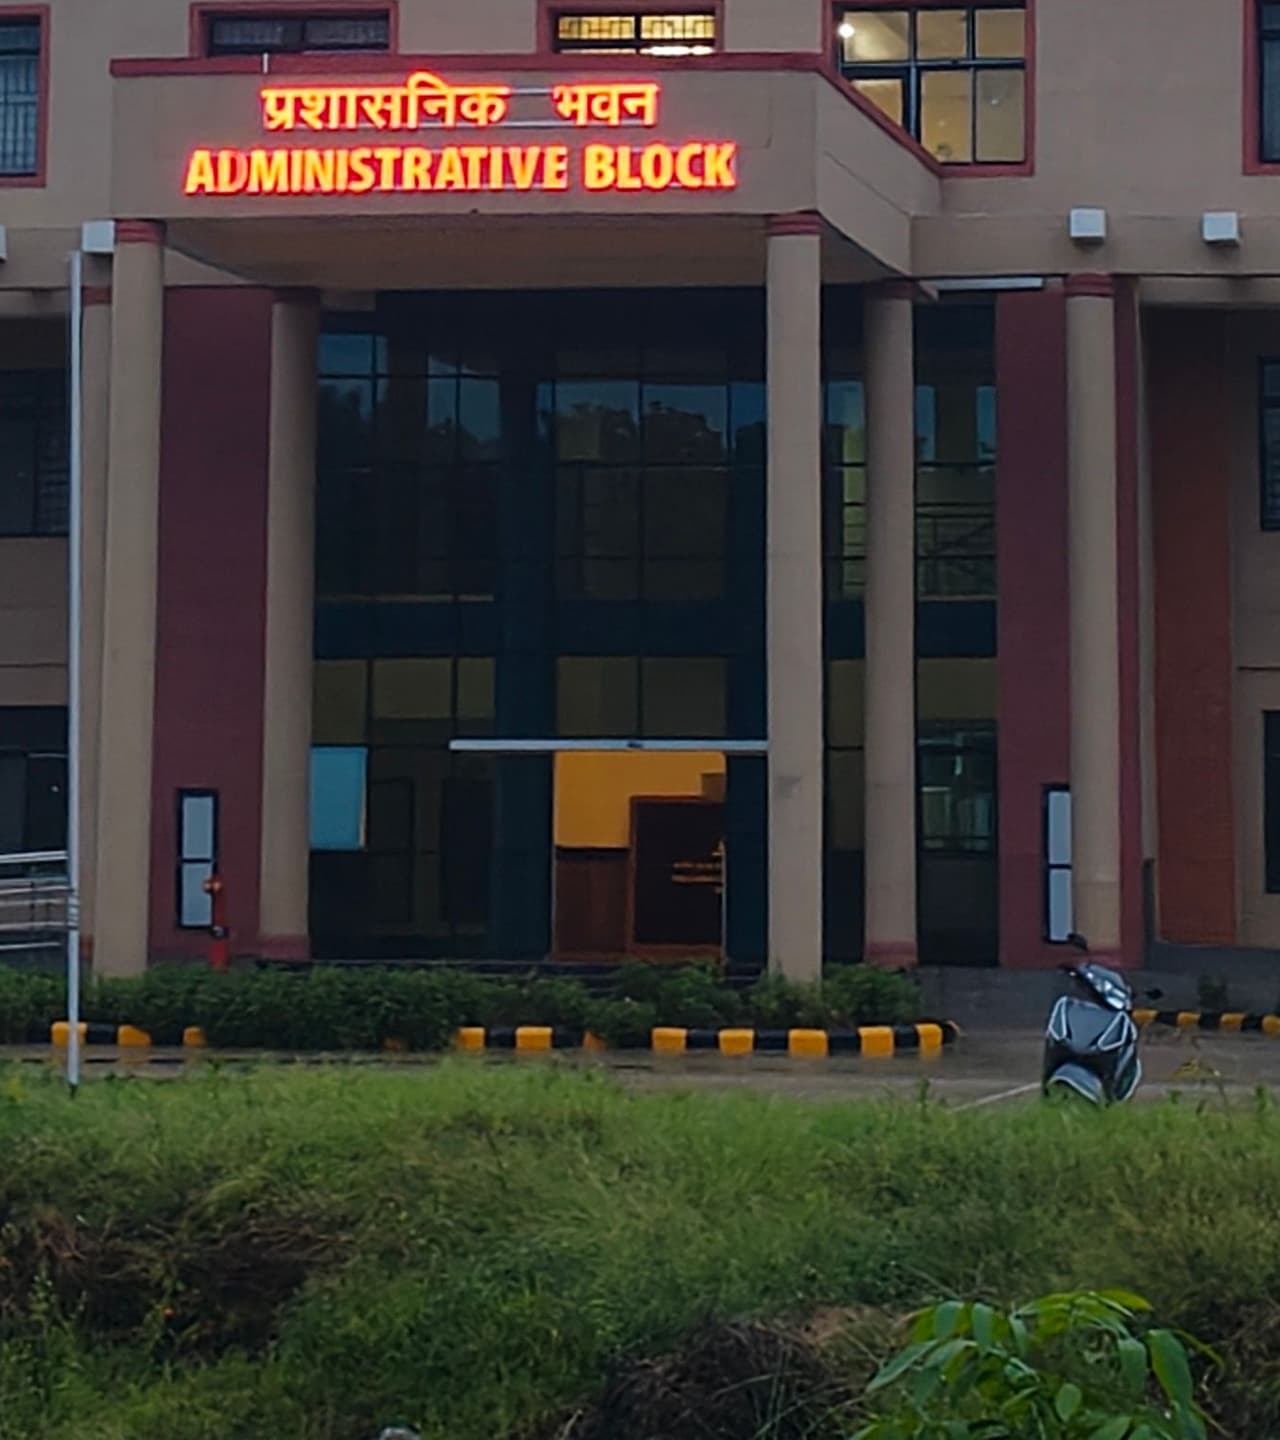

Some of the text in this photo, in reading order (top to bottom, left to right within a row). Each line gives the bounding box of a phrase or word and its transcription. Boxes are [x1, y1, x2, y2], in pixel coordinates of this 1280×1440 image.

[261, 71, 659, 131] प्रशासनिक भवन
[184, 142, 737, 194] ADMINISTRATIVE BLOCK
